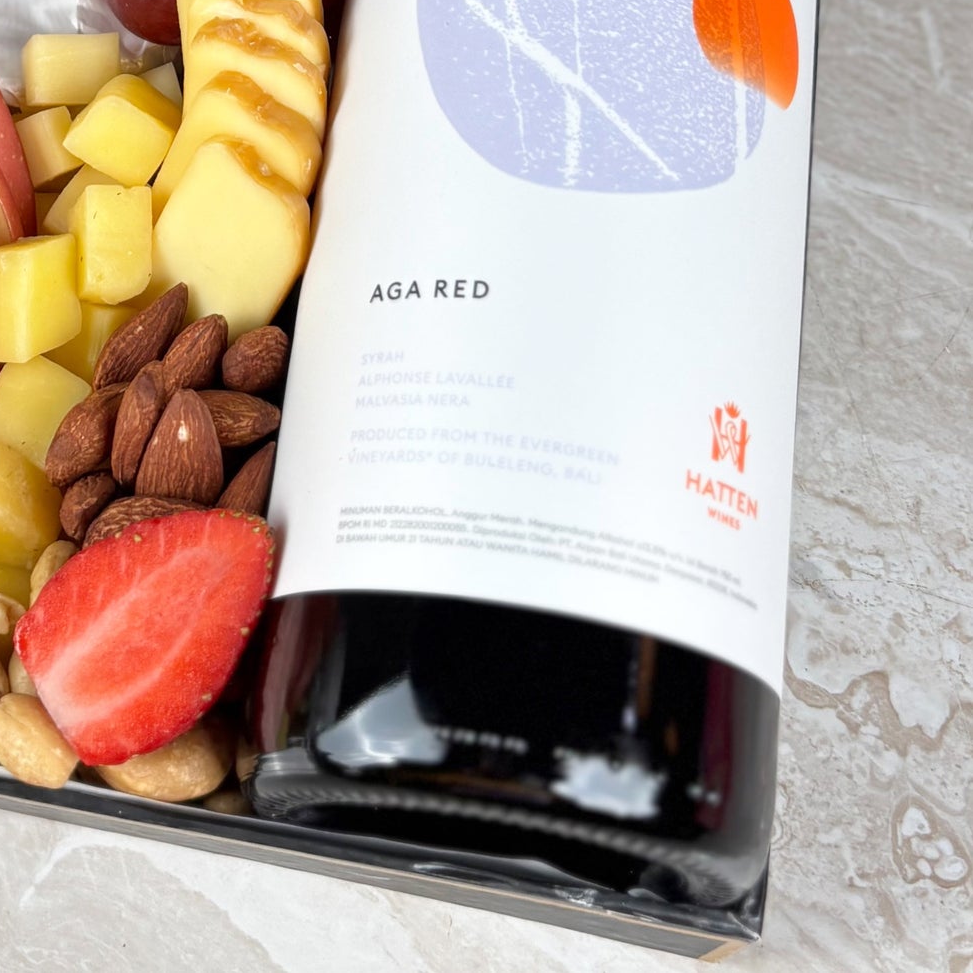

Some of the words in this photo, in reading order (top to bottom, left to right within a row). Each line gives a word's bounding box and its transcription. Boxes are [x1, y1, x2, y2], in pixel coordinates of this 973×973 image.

[369, 280, 422, 304] AGA
[433, 279, 491, 299] RED
[360, 351, 404, 366] SYRAH
[357, 371, 432, 388] ALPHONSE
[355, 393, 424, 410] MALVASIA
[427, 393, 470, 408] NERA
[350, 427, 426, 443] PRODUCED
[430, 429, 477, 443] FROM
[483, 431, 515, 447] THE
[520, 436, 620, 466] EVERGREEN
[437, 451, 459, 464] OF
[464, 453, 558, 479] BULELENG,
[564, 466, 603, 485] BALI
[686, 469, 758, 520] HATTEN
[340, 506, 381, 515] MINUMAN
[707, 506, 740, 530] WINES
